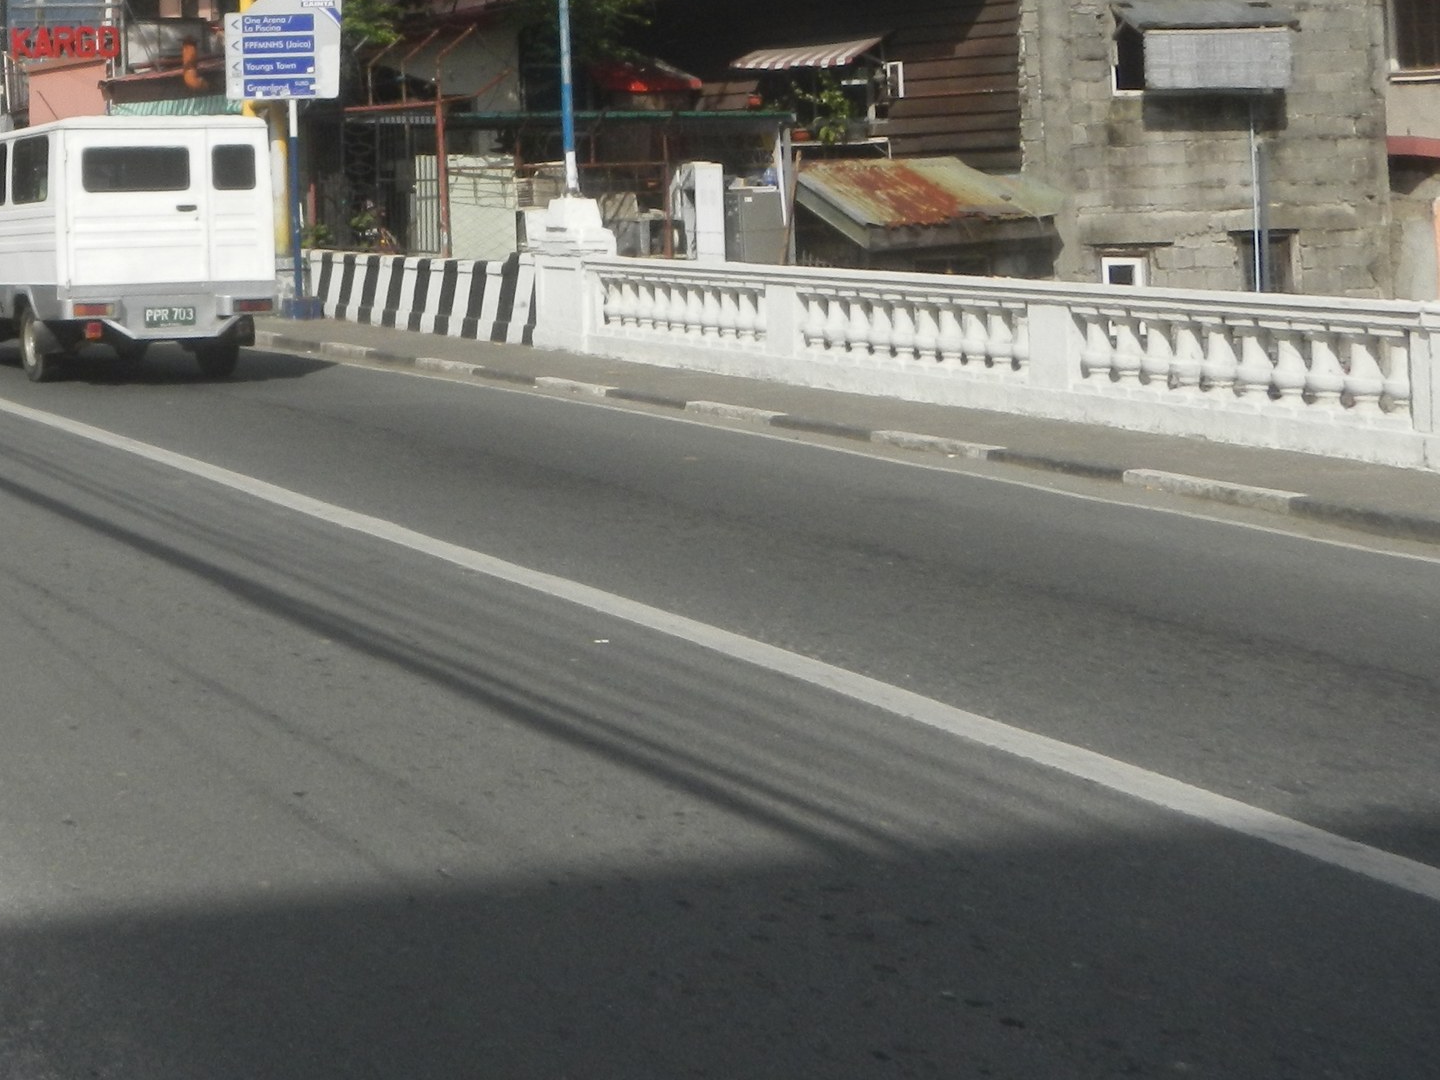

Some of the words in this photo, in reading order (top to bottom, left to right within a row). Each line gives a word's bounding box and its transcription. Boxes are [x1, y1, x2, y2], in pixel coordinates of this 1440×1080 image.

[244, 16, 261, 25] One
[262, 16, 286, 24] Arena
[244, 24, 254, 32] La
[255, 23, 282, 32] Piscina
[10, 25, 120, 59] KARGO
[246, 63, 274, 73] Youngs
[276, 61, 297, 70] Town
[247, 83, 290, 93] Greenland
[146, 310, 168, 321] PPR
[172, 308, 193, 320] 703
